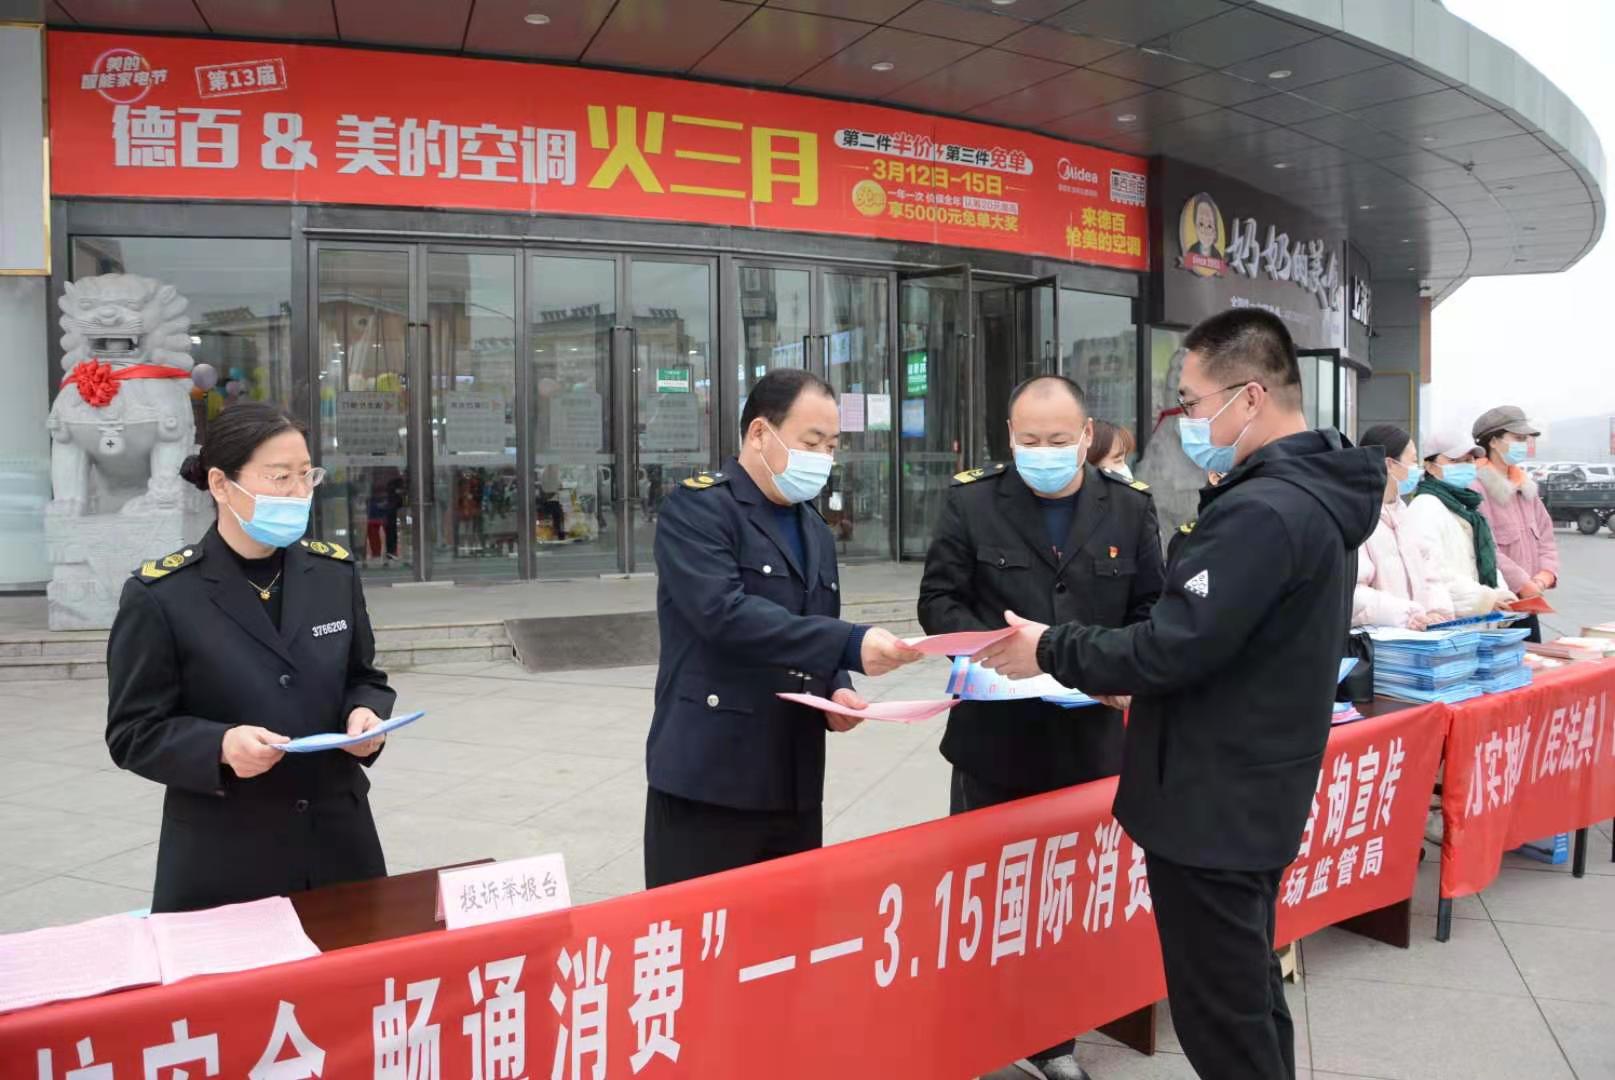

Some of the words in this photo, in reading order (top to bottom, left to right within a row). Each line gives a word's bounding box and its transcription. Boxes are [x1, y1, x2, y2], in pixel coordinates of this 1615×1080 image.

[207, 64, 278, 91] 第13届
[113, 104, 242, 169] 德百
[1057, 158, 1098, 184] Midea
[887, 201, 1019, 232] 享5000元免单大奖
[460, 872, 557, 912] 投诉举报台
